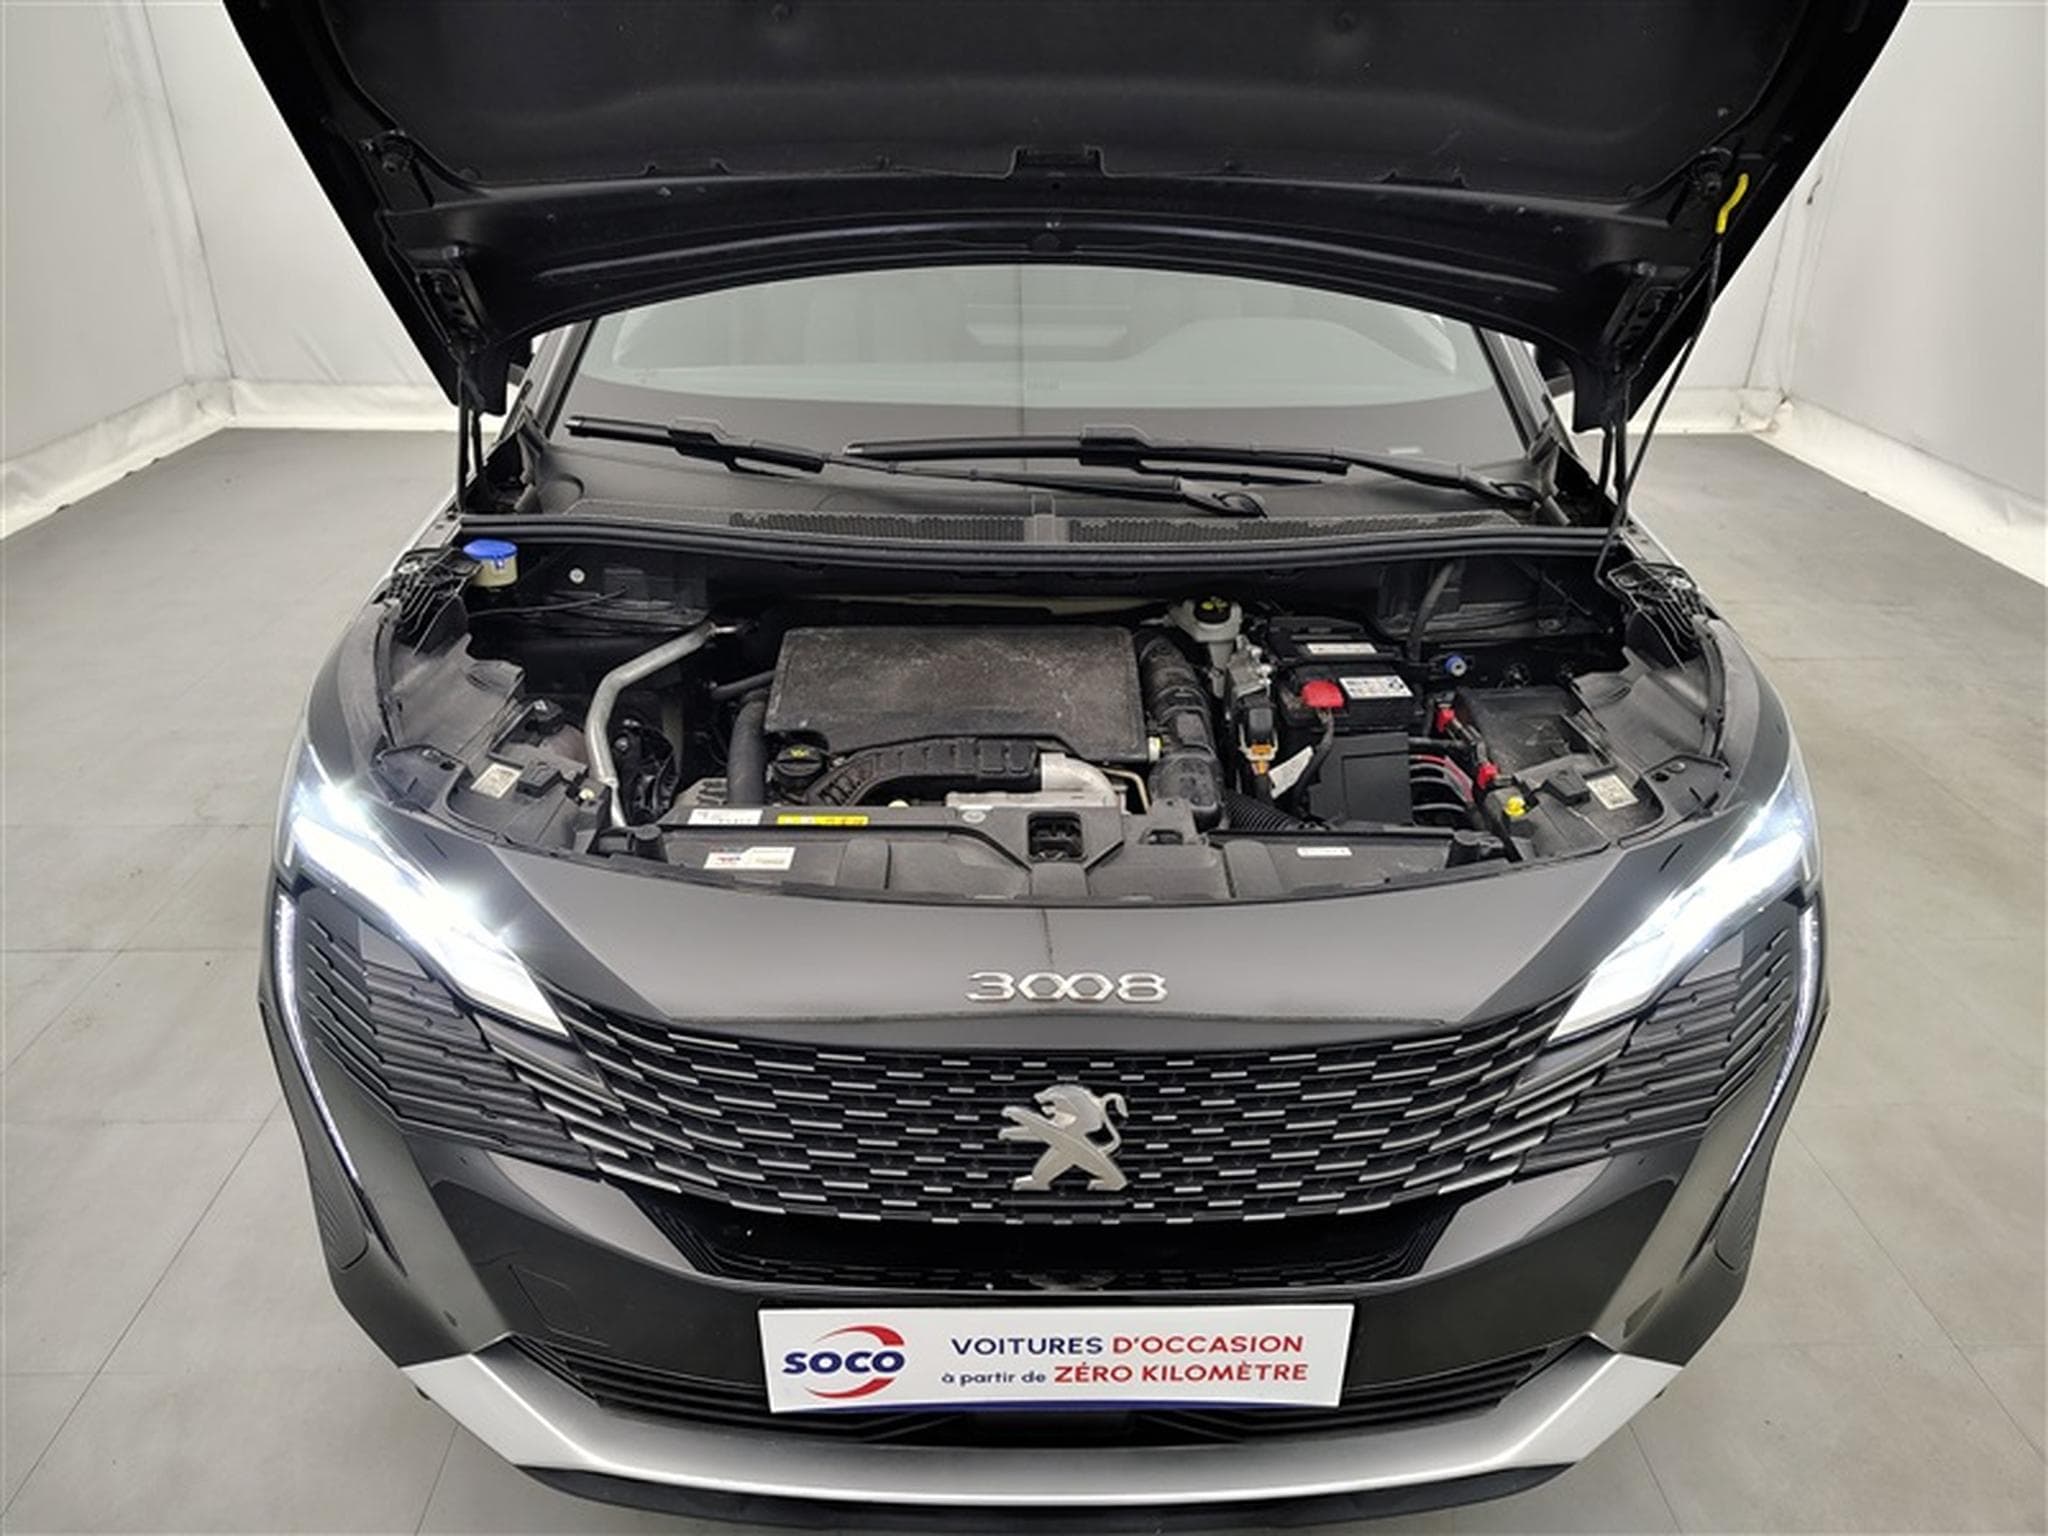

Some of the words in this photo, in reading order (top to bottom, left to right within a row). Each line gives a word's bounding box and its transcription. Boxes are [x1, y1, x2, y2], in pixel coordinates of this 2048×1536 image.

[966, 970, 1168, 1002] 3008
[951, 1337, 1103, 1355] VOITURES
[1113, 1336, 1303, 1353] D'OCCASION
[782, 1351, 905, 1374] SOCO
[941, 1372, 954, 1384] à
[960, 1371, 1015, 1386] partir
[1021, 1371, 1046, 1384] de
[1054, 1362, 1132, 1383] ZÉRO
[1142, 1361, 1308, 1382] KILOMÈTRE
